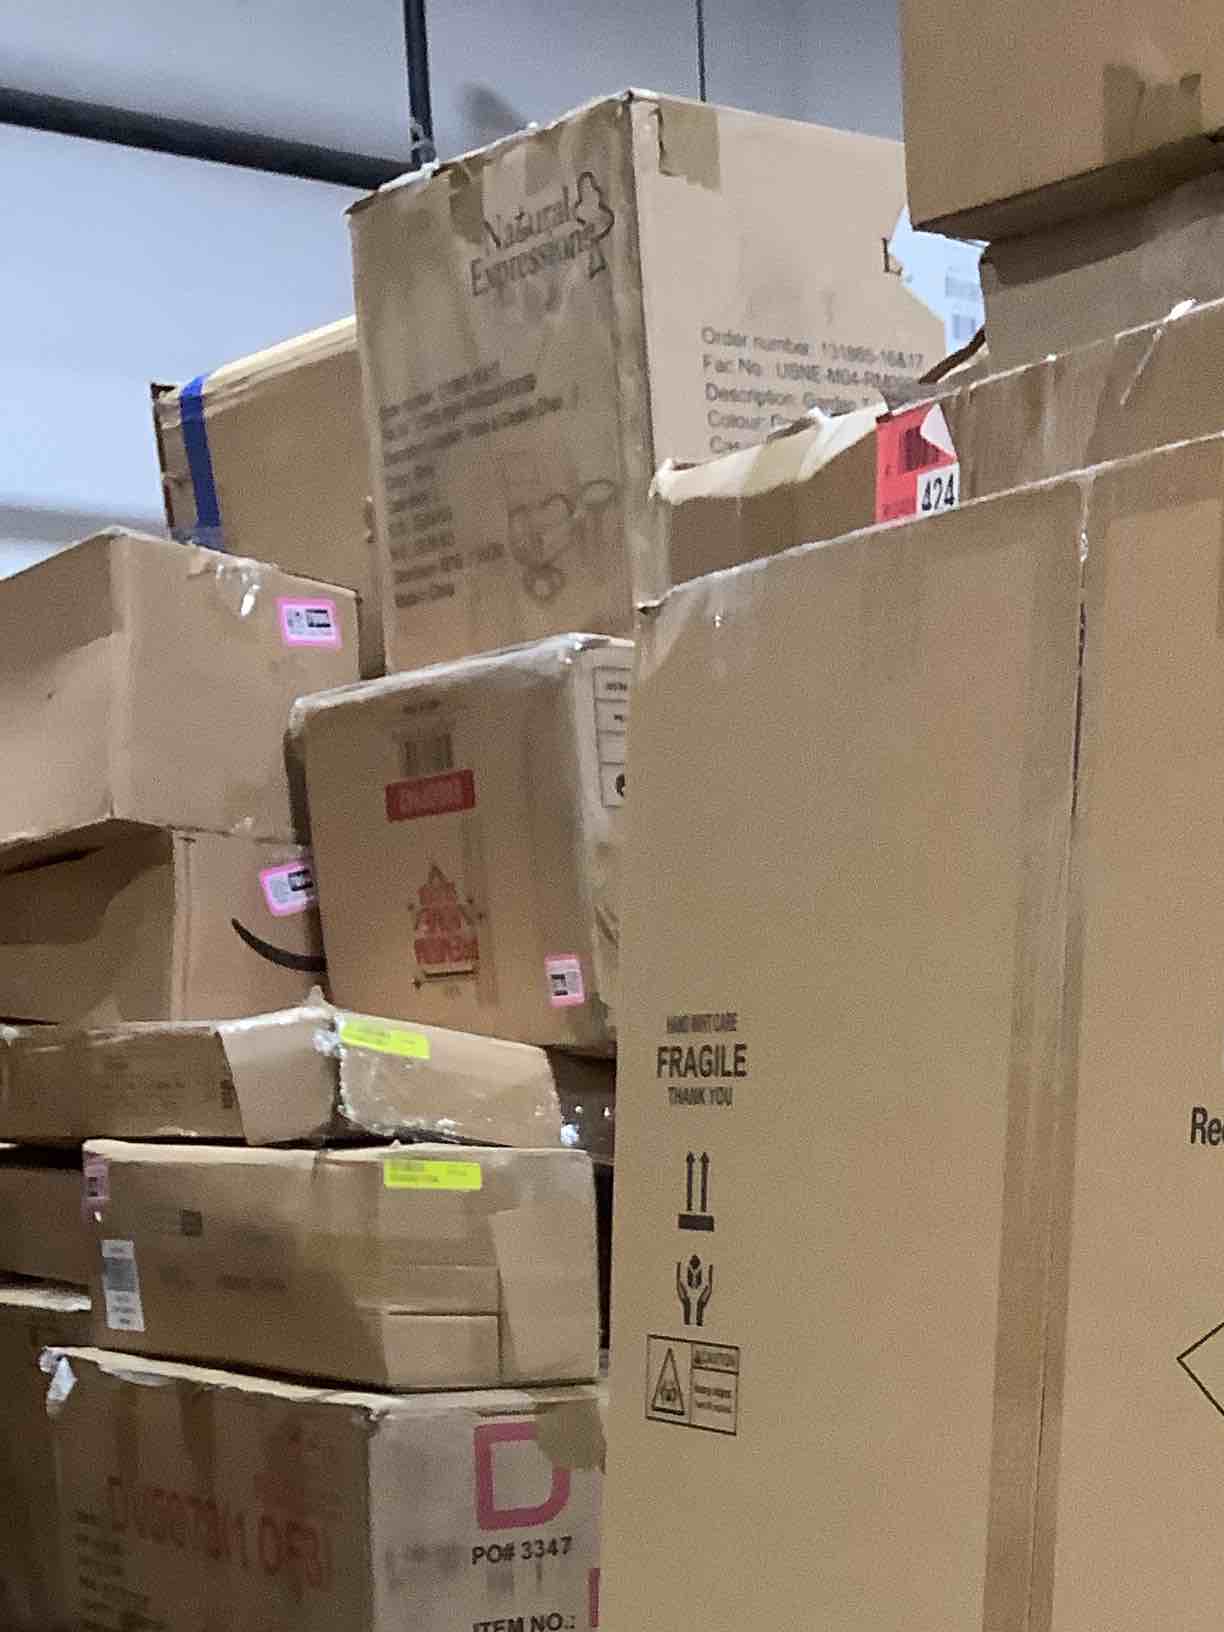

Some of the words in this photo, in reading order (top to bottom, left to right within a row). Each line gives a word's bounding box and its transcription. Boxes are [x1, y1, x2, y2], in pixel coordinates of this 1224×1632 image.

[701, 327, 747, 348] Order
[921, 473, 955, 512] 424
[656, 1043, 748, 1079] FRAGILE
[667, 1086, 705, 1106] THANK
[709, 1086, 734, 1106] YOU
[471, 1542, 515, 1565] PO#
[521, 1536, 573, 1560] 3347
